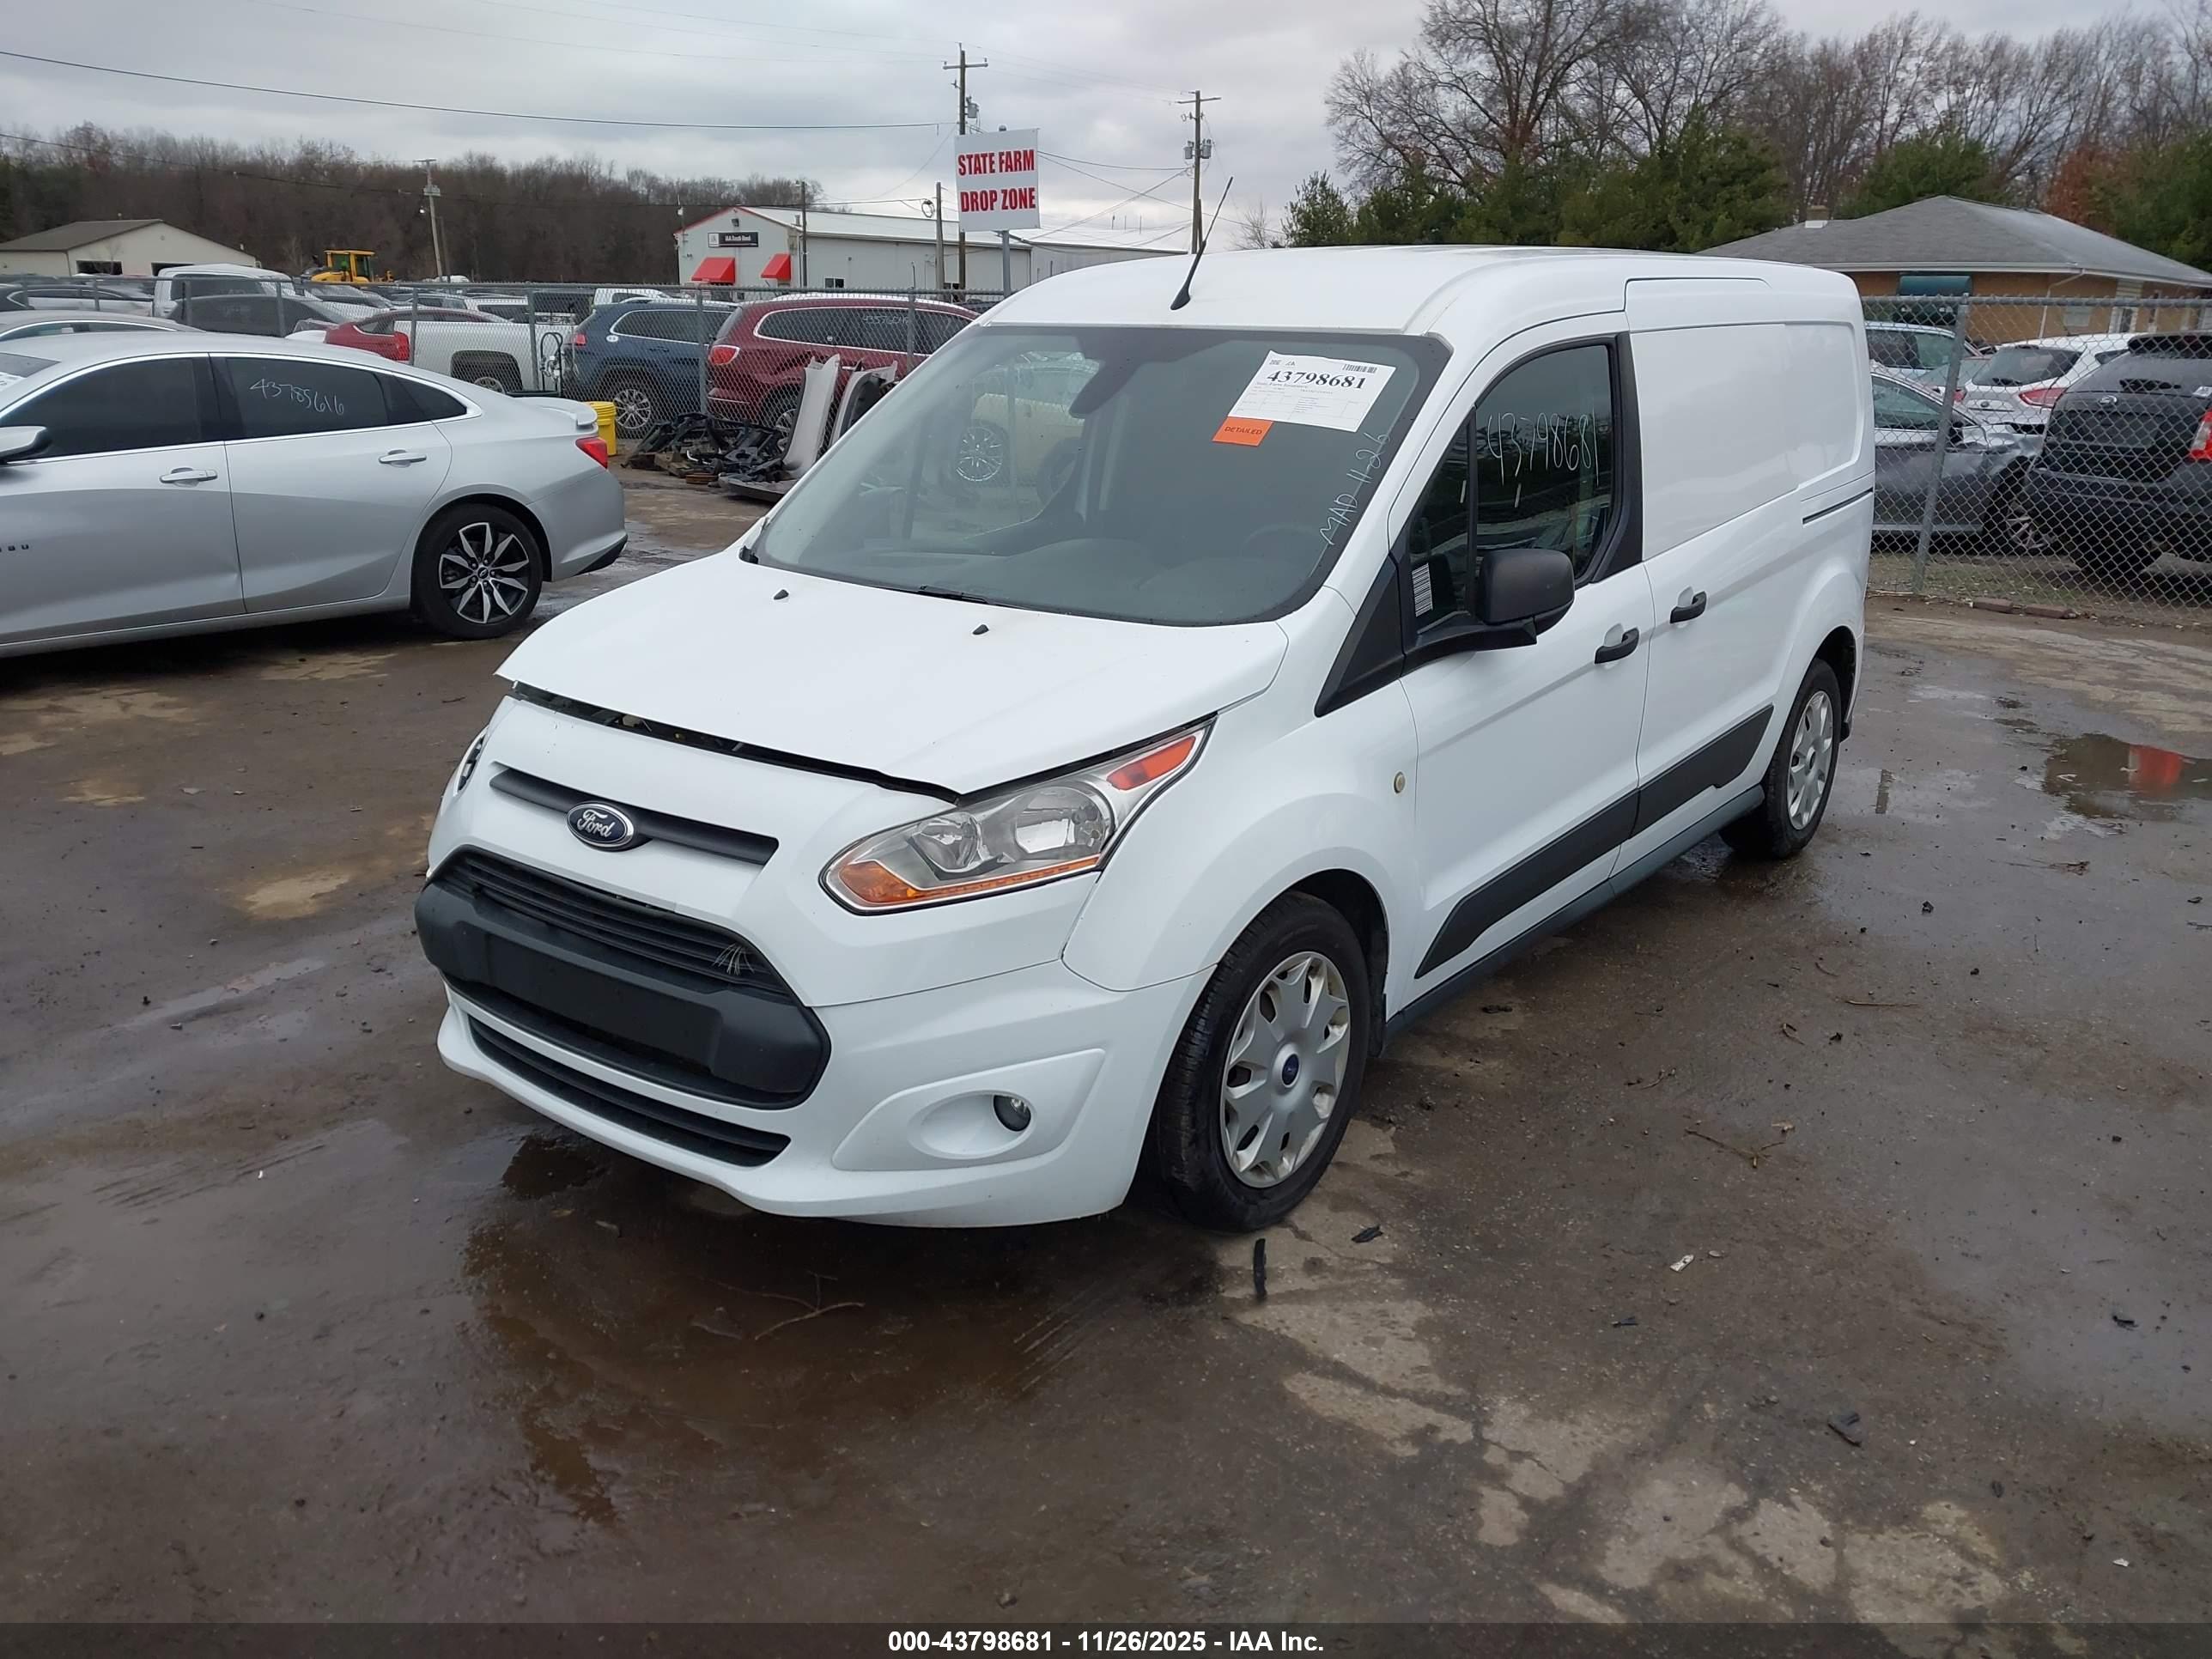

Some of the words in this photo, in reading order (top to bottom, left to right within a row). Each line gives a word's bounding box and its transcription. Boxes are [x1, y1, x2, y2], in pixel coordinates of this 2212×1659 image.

[957, 153, 996, 176] STATE
[999, 149, 1035, 173] FARM
[960, 190, 998, 212] DROP
[1000, 187, 1036, 210] ZONE
[1266, 370, 1366, 389] 43798681
[249, 378, 344, 416] 43785616
[1224, 426, 1262, 435] DETAILED
[1487, 407, 1599, 488] 43798681
[1319, 493, 1358, 546] MAD
[576, 809, 616, 837] Ford
